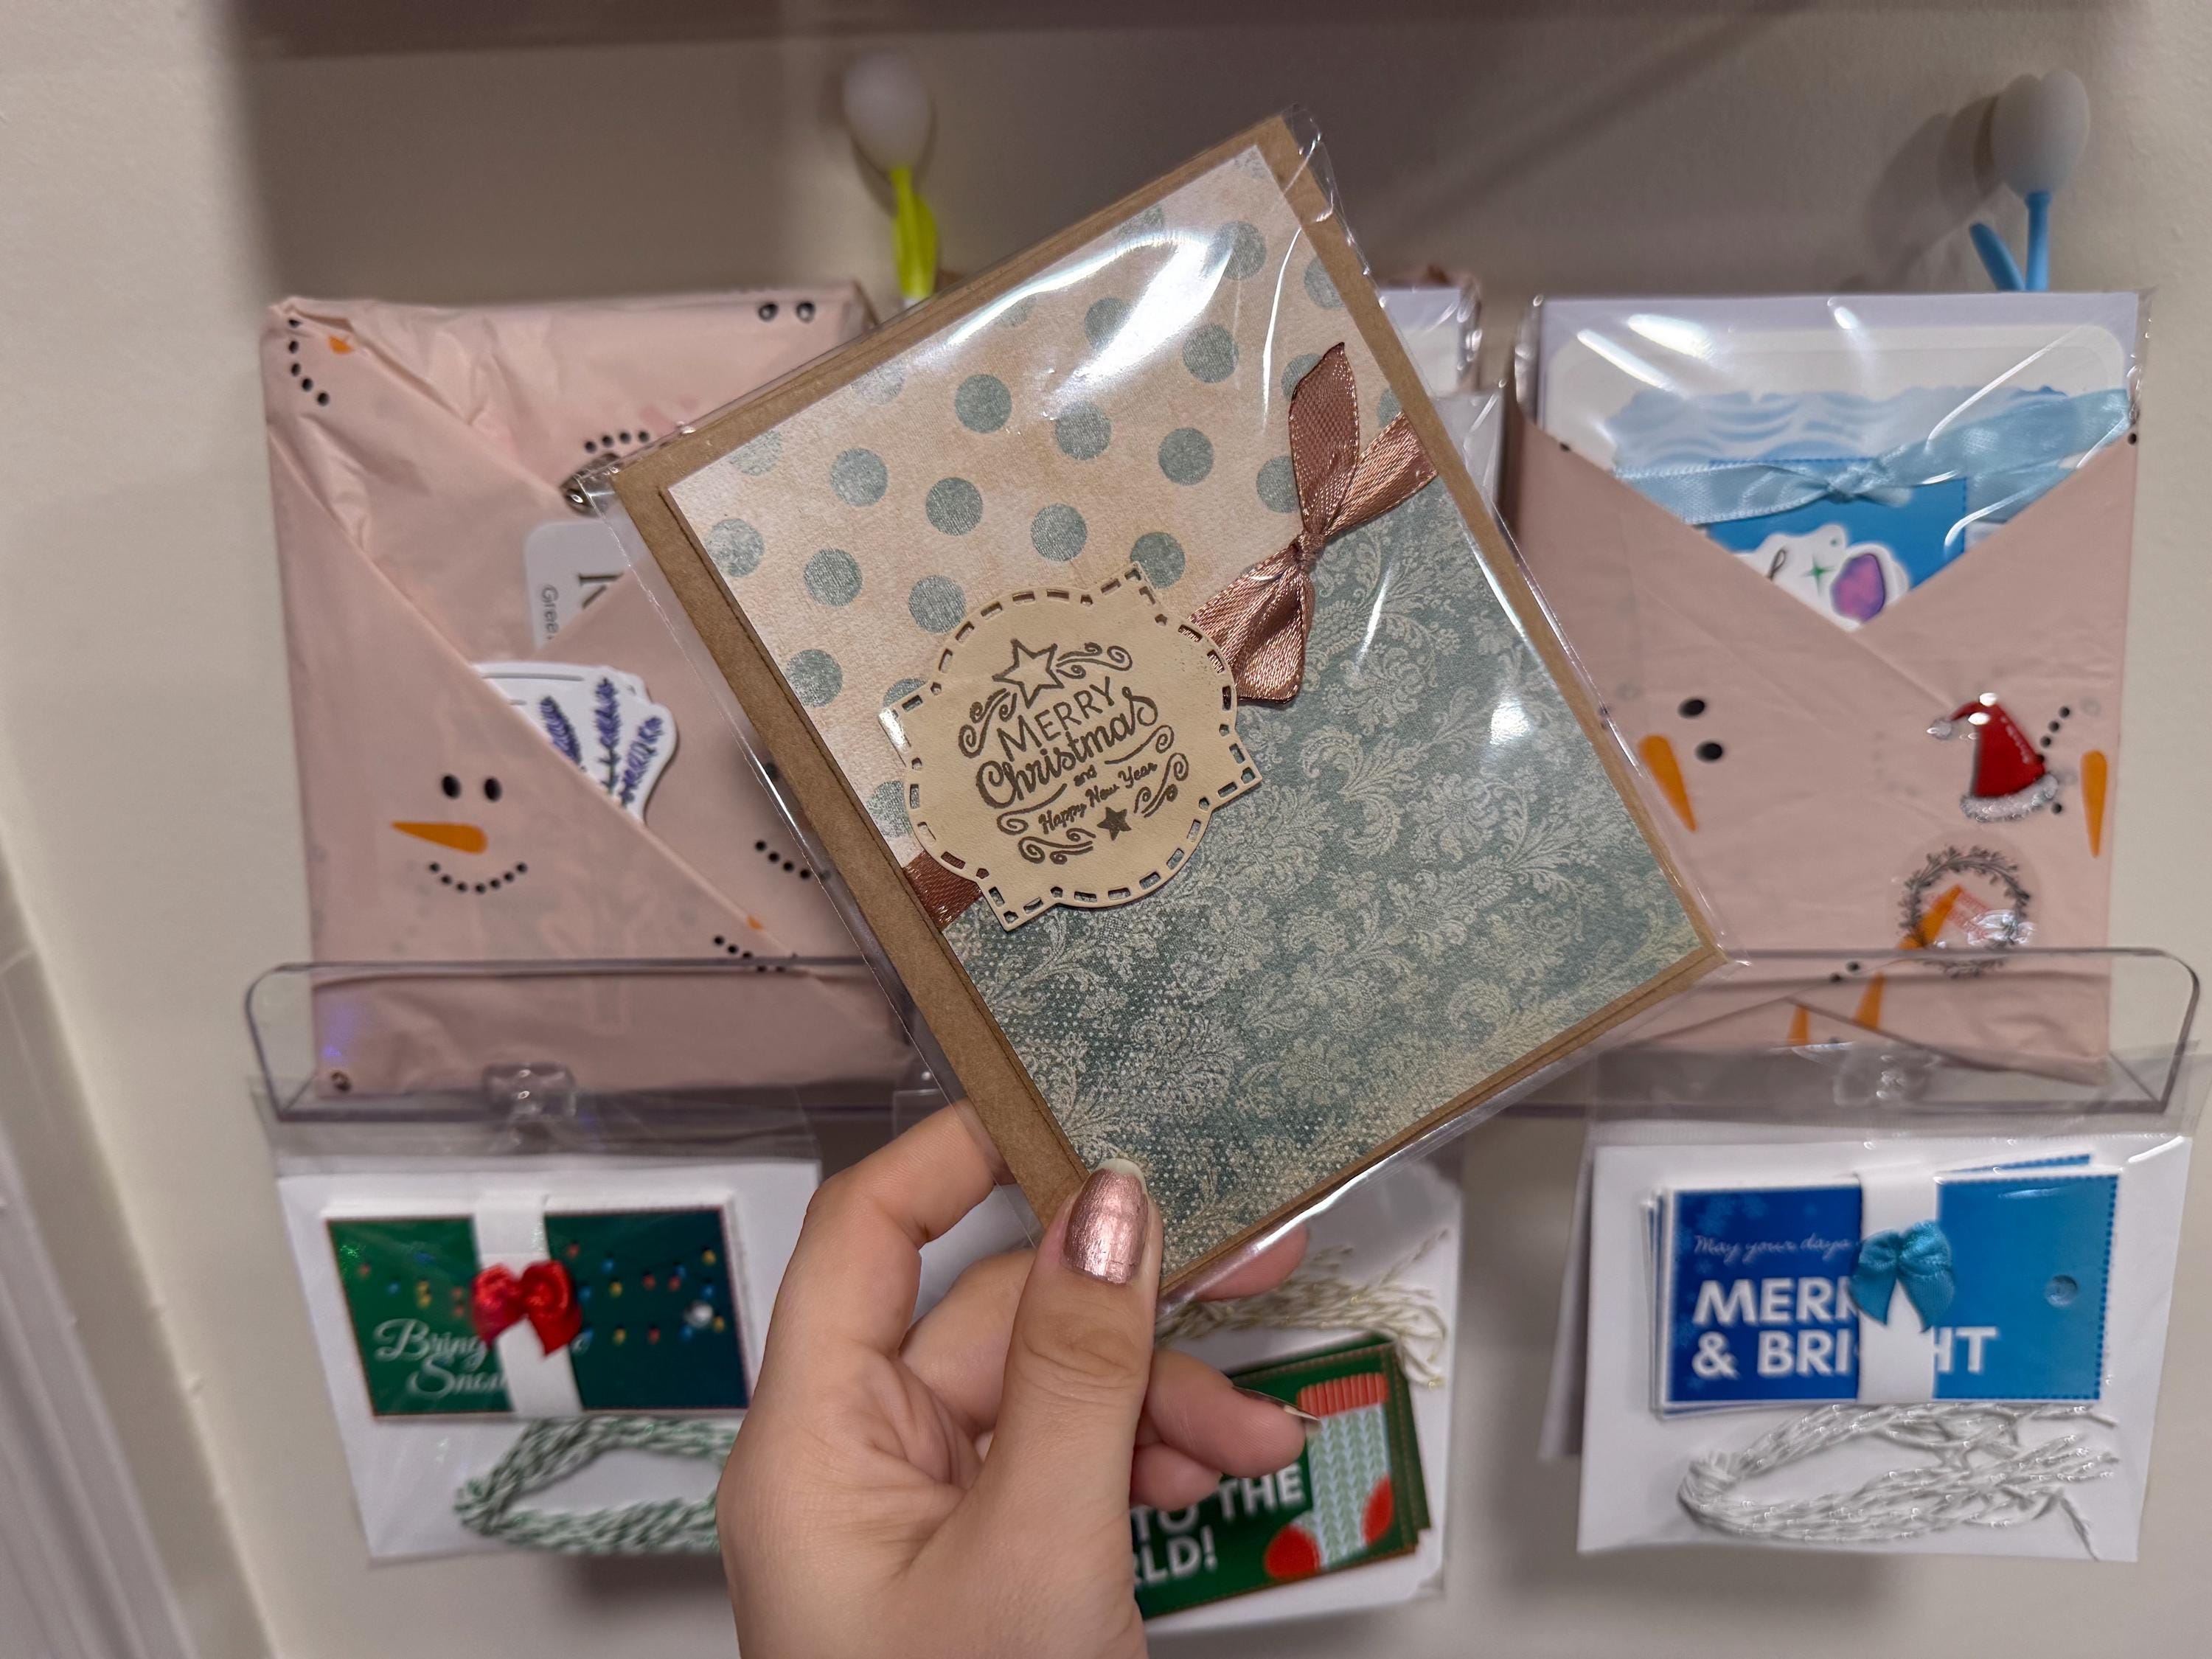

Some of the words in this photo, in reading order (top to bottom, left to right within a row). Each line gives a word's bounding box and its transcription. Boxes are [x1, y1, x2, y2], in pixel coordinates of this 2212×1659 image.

[975, 686, 1158, 809] Christmas
[996, 676, 1114, 762] MERRY
[1038, 804, 1087, 834] Happy
[1085, 785, 1119, 807] New
[1118, 762, 1158, 789] Year
[1073, 765, 1097, 787] and
[1694, 1234, 1740, 1266] May
[1742, 1240, 1796, 1265] your
[372, 1318, 487, 1371] Bring
[1691, 1330, 1739, 1380] &
[1756, 1326, 1997, 1377] BRIHT
[1218, 1461, 1304, 1522] THE
